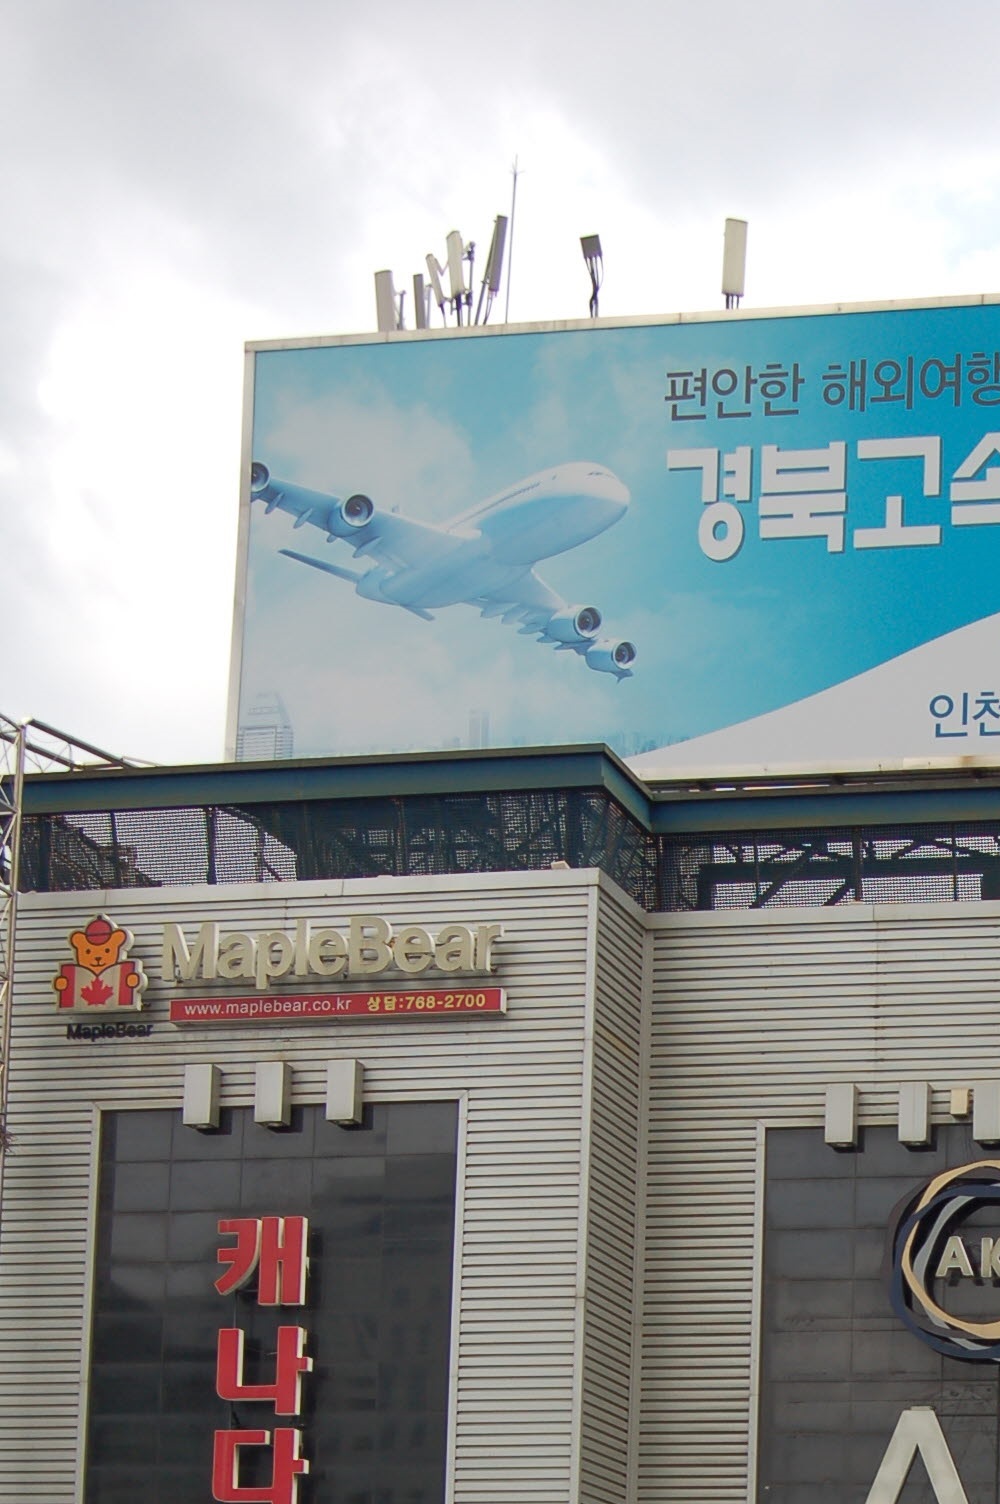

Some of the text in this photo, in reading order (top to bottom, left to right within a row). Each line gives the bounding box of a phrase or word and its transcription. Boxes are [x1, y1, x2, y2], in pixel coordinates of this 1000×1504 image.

[664, 362, 805, 421] 편안한
[162, 916, 505, 990] MapleBear
[184, 996, 352, 1017] www.maplebear.co.kr
[66, 1022, 153, 1042] MapleBear
